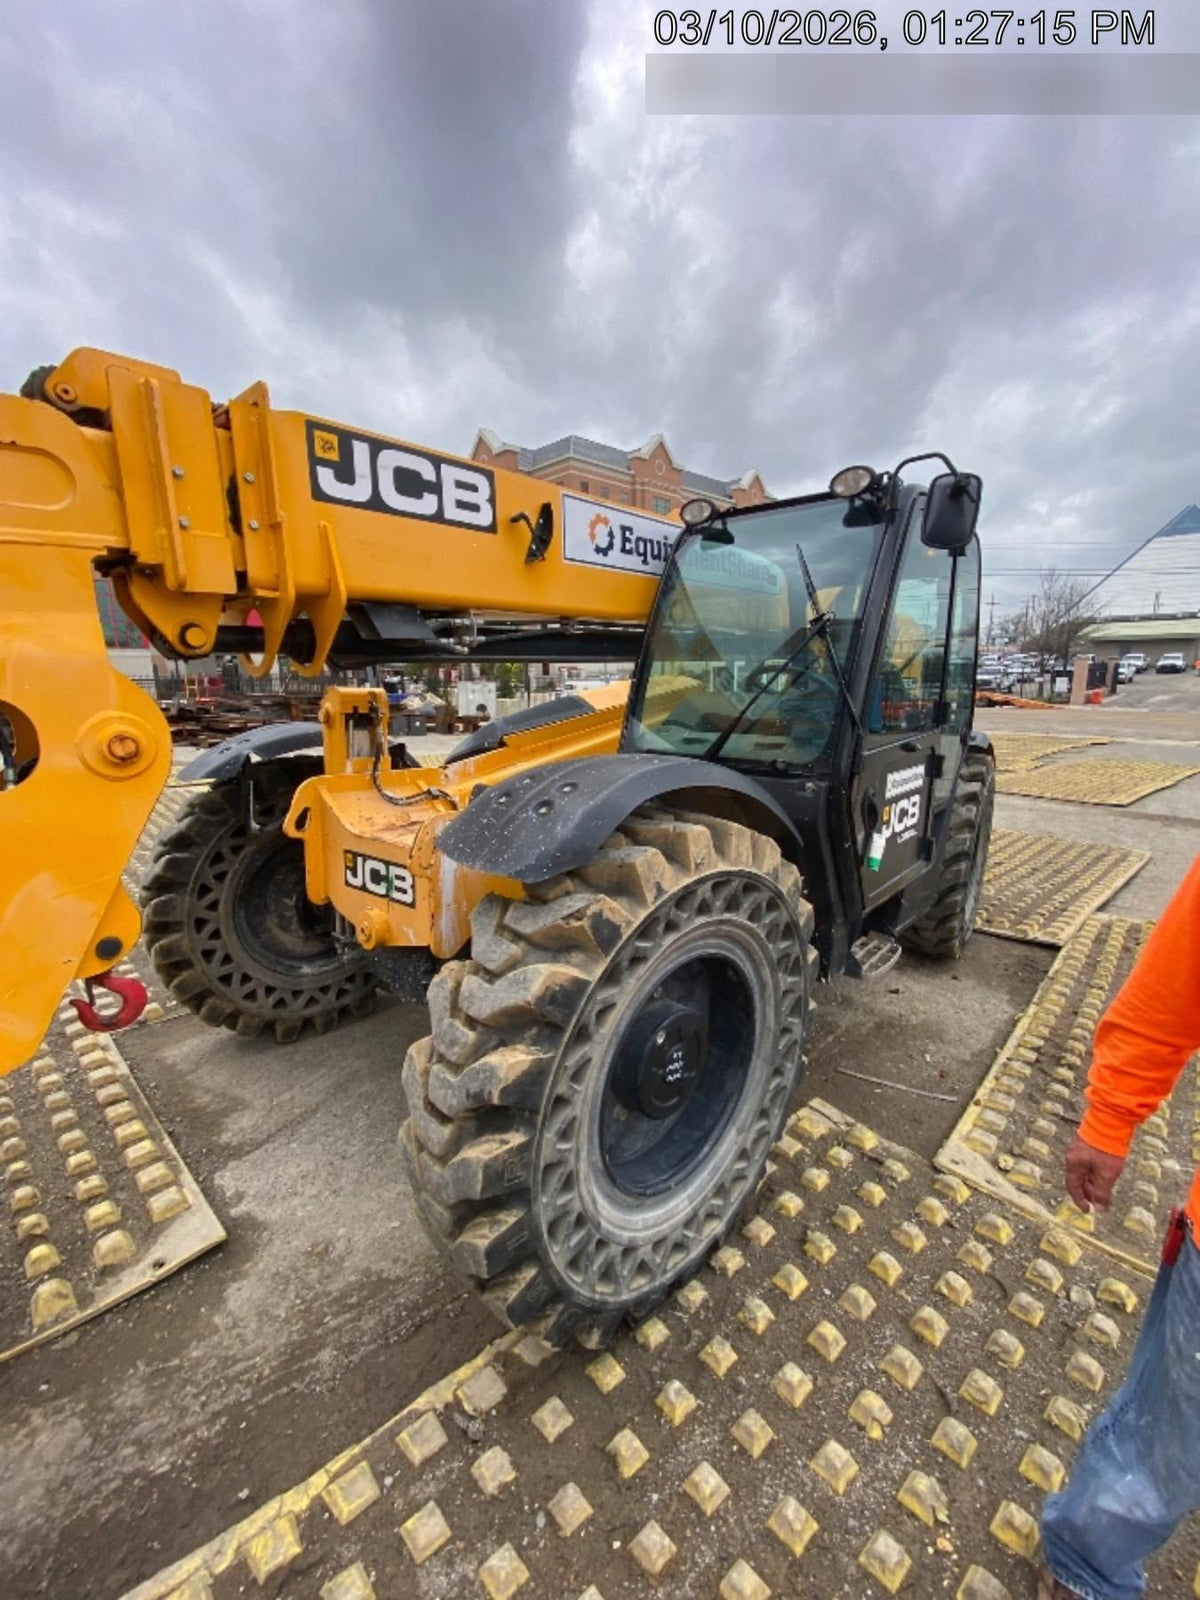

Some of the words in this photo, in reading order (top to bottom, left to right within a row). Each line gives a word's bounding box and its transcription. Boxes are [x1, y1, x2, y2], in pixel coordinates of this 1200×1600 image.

[315, 438, 494, 528] JCB
[881, 794, 920, 838] JCB
[346, 856, 414, 904] JCB
